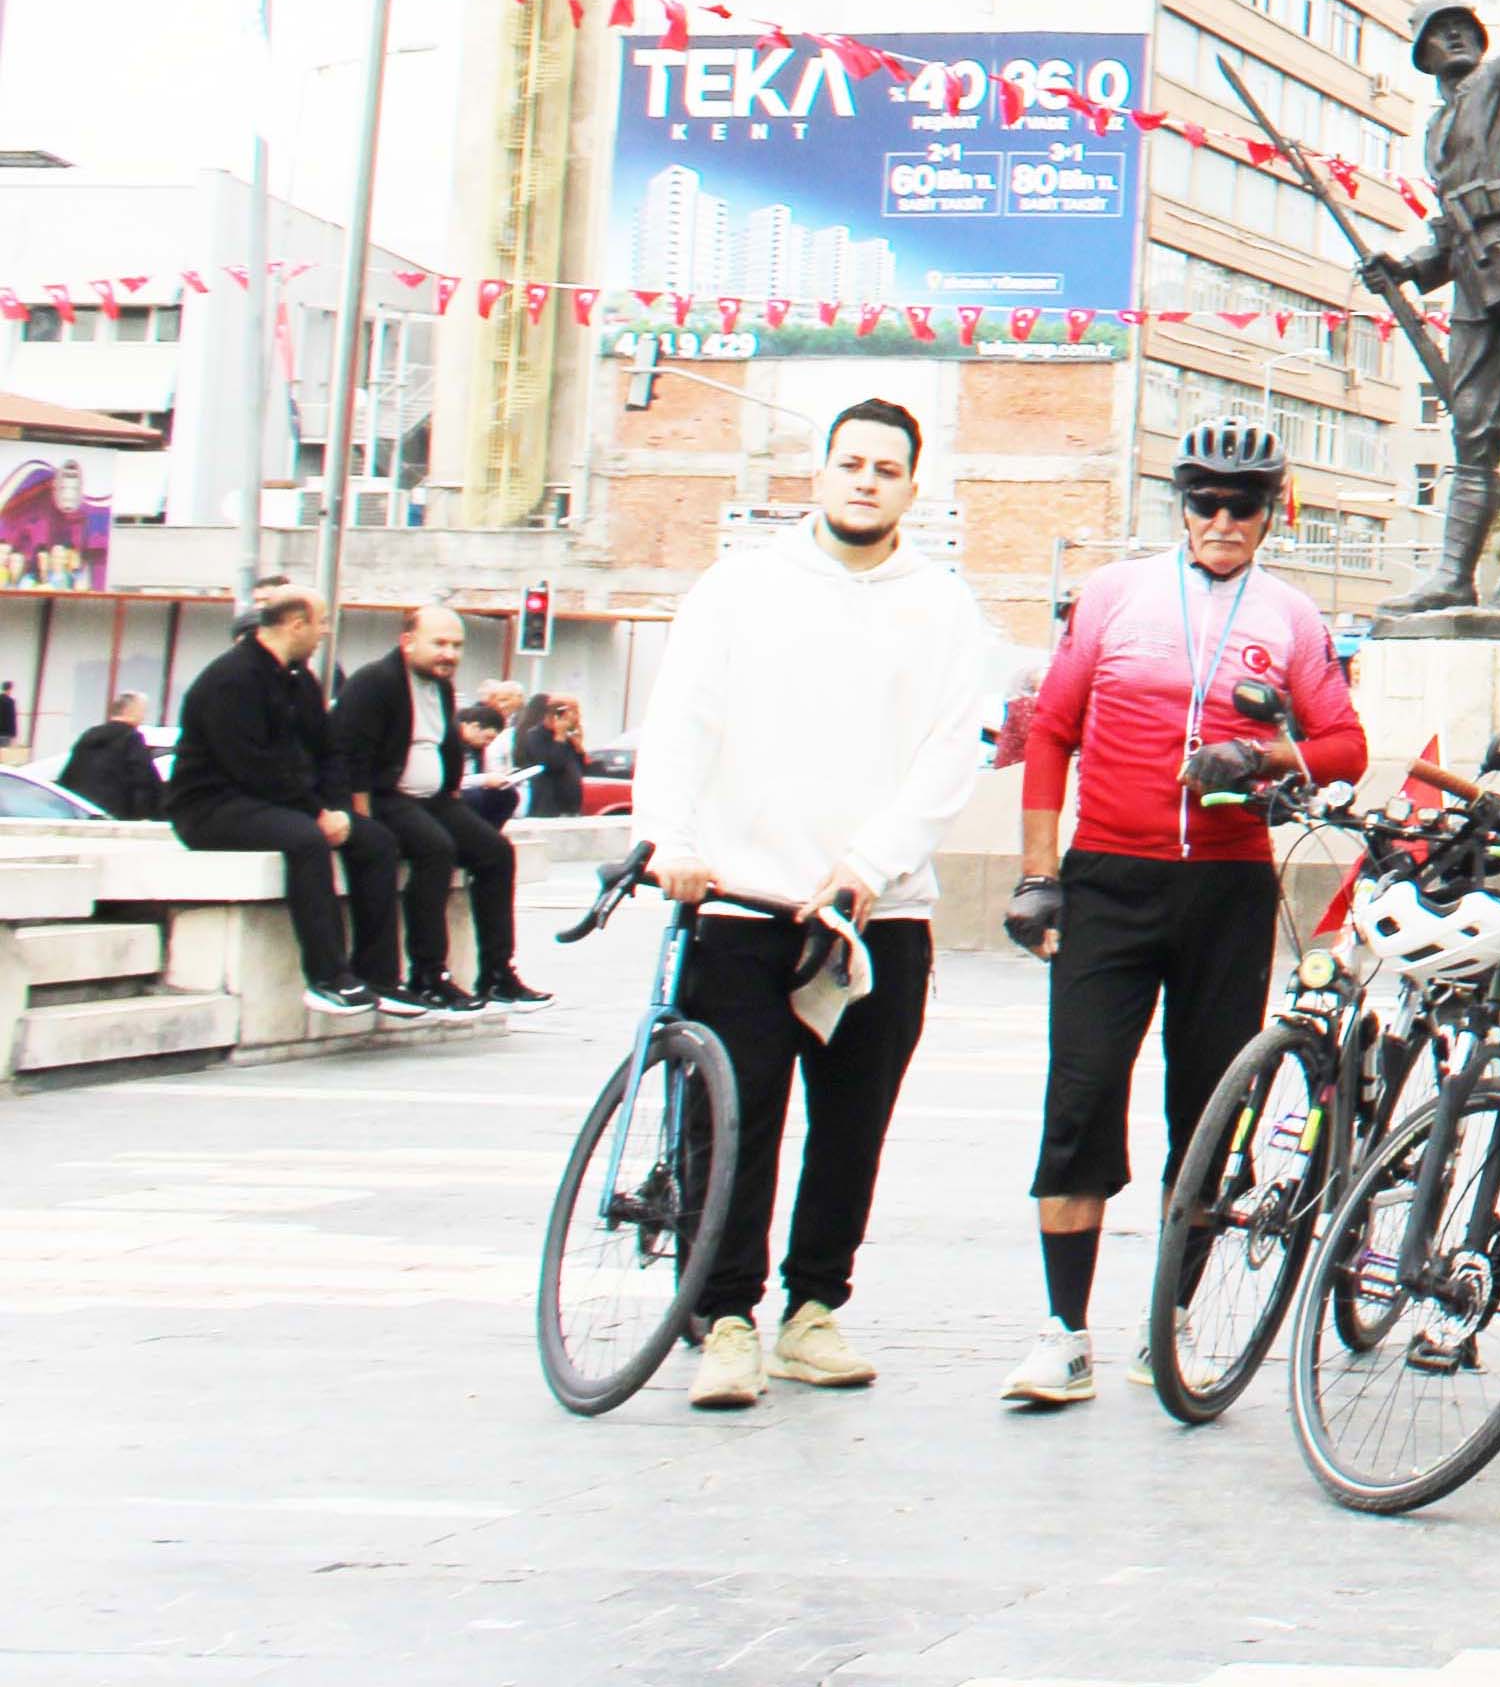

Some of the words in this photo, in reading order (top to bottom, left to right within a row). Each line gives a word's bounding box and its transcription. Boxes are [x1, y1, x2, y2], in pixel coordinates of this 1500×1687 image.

[671, 123, 809, 141] KENT
[890, 164, 937, 195] 60
[1011, 164, 1058, 195] 80
